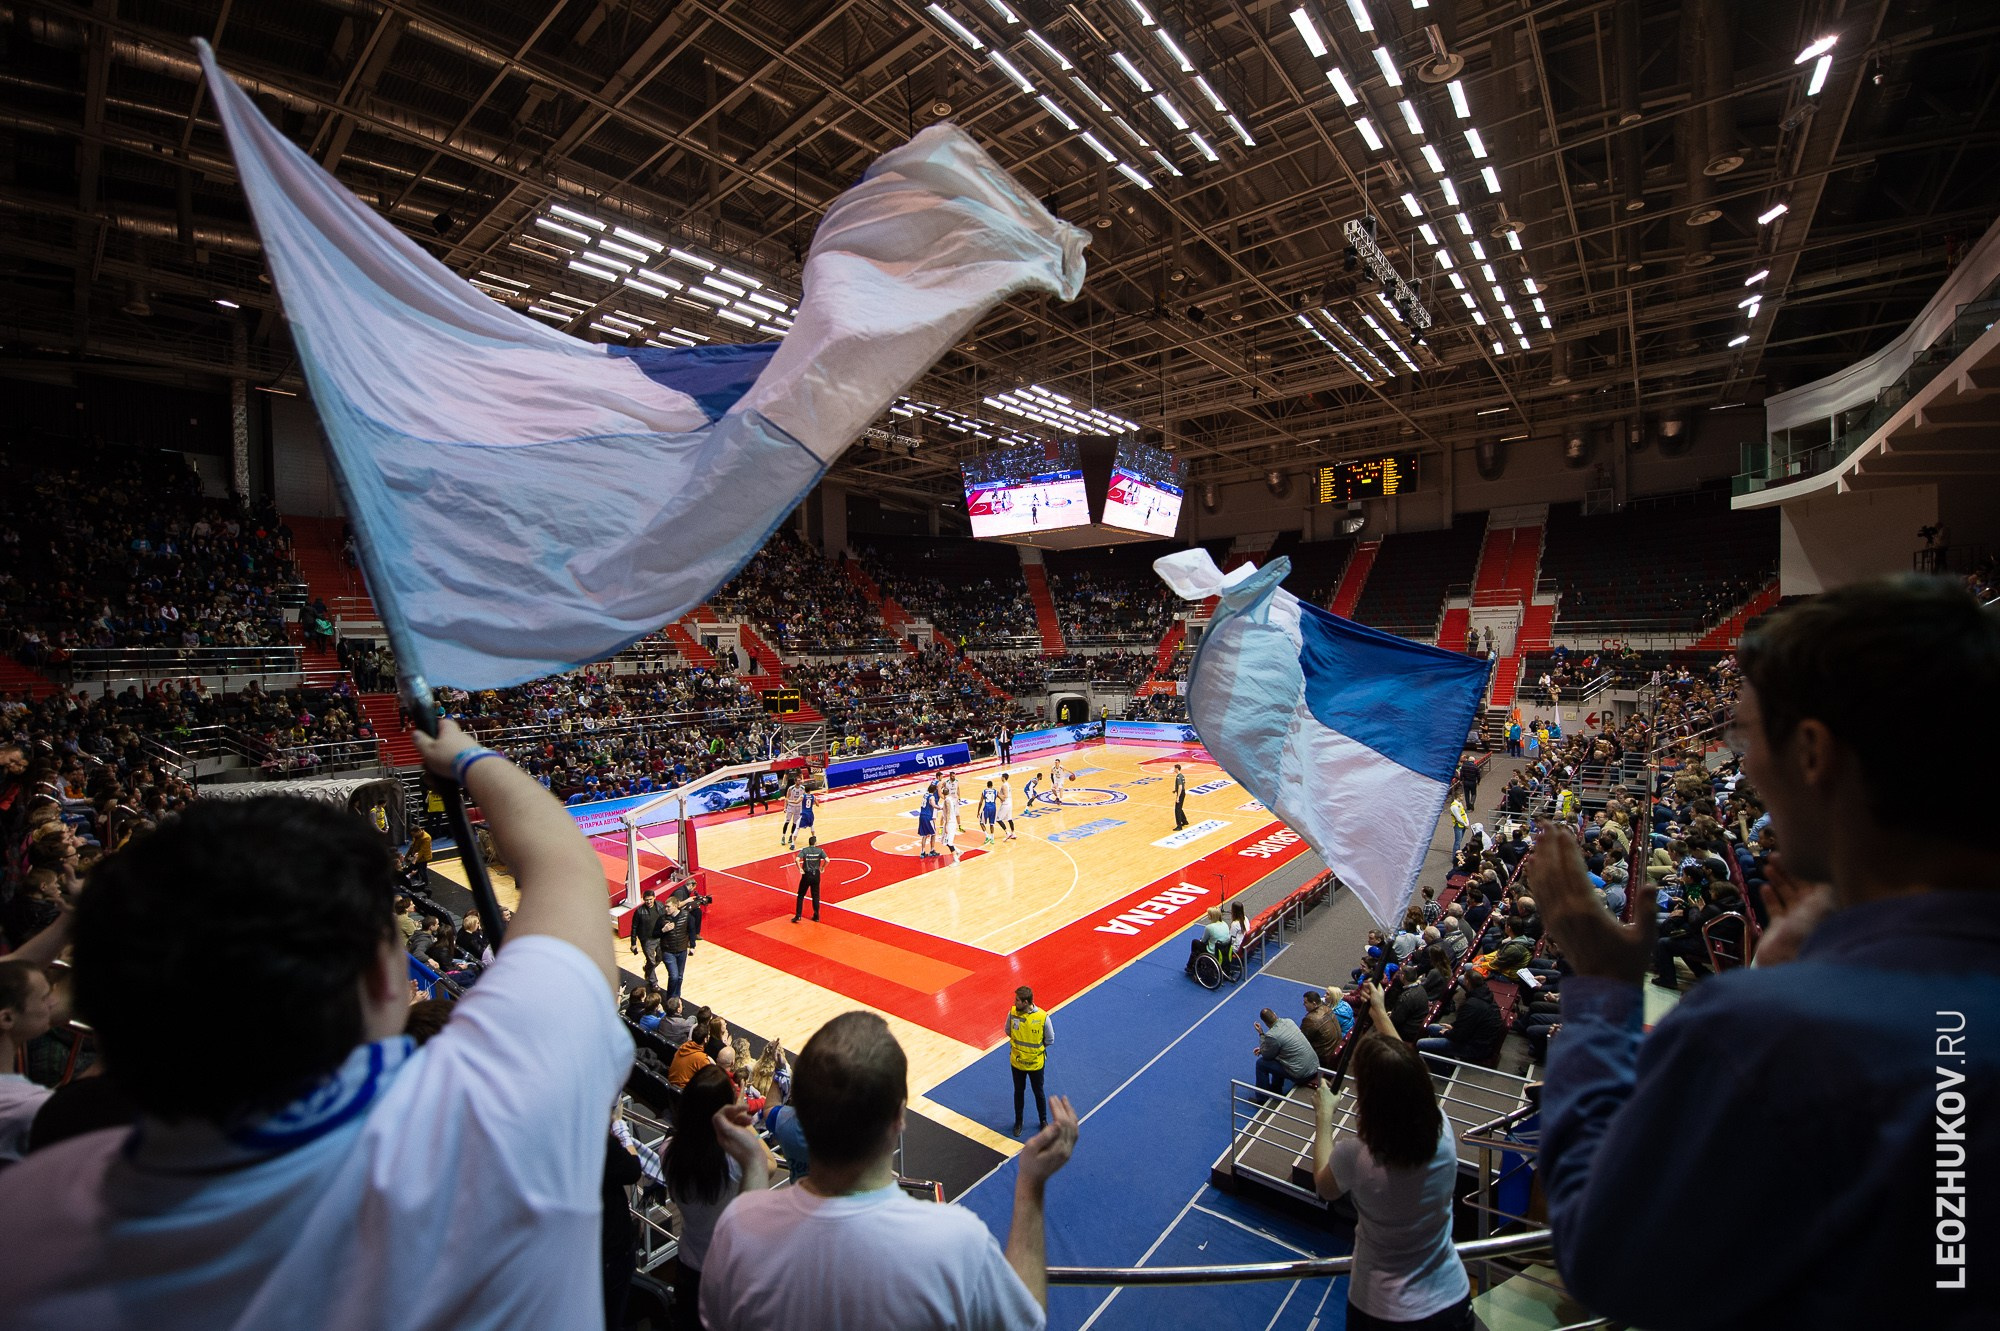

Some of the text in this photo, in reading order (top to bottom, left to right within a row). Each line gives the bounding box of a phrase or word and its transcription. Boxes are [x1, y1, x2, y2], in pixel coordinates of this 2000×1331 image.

[926, 754, 945, 768] ВТБ
[603, 816, 621, 826] АВТОМ
[1093, 881, 1210, 936] ARENA
